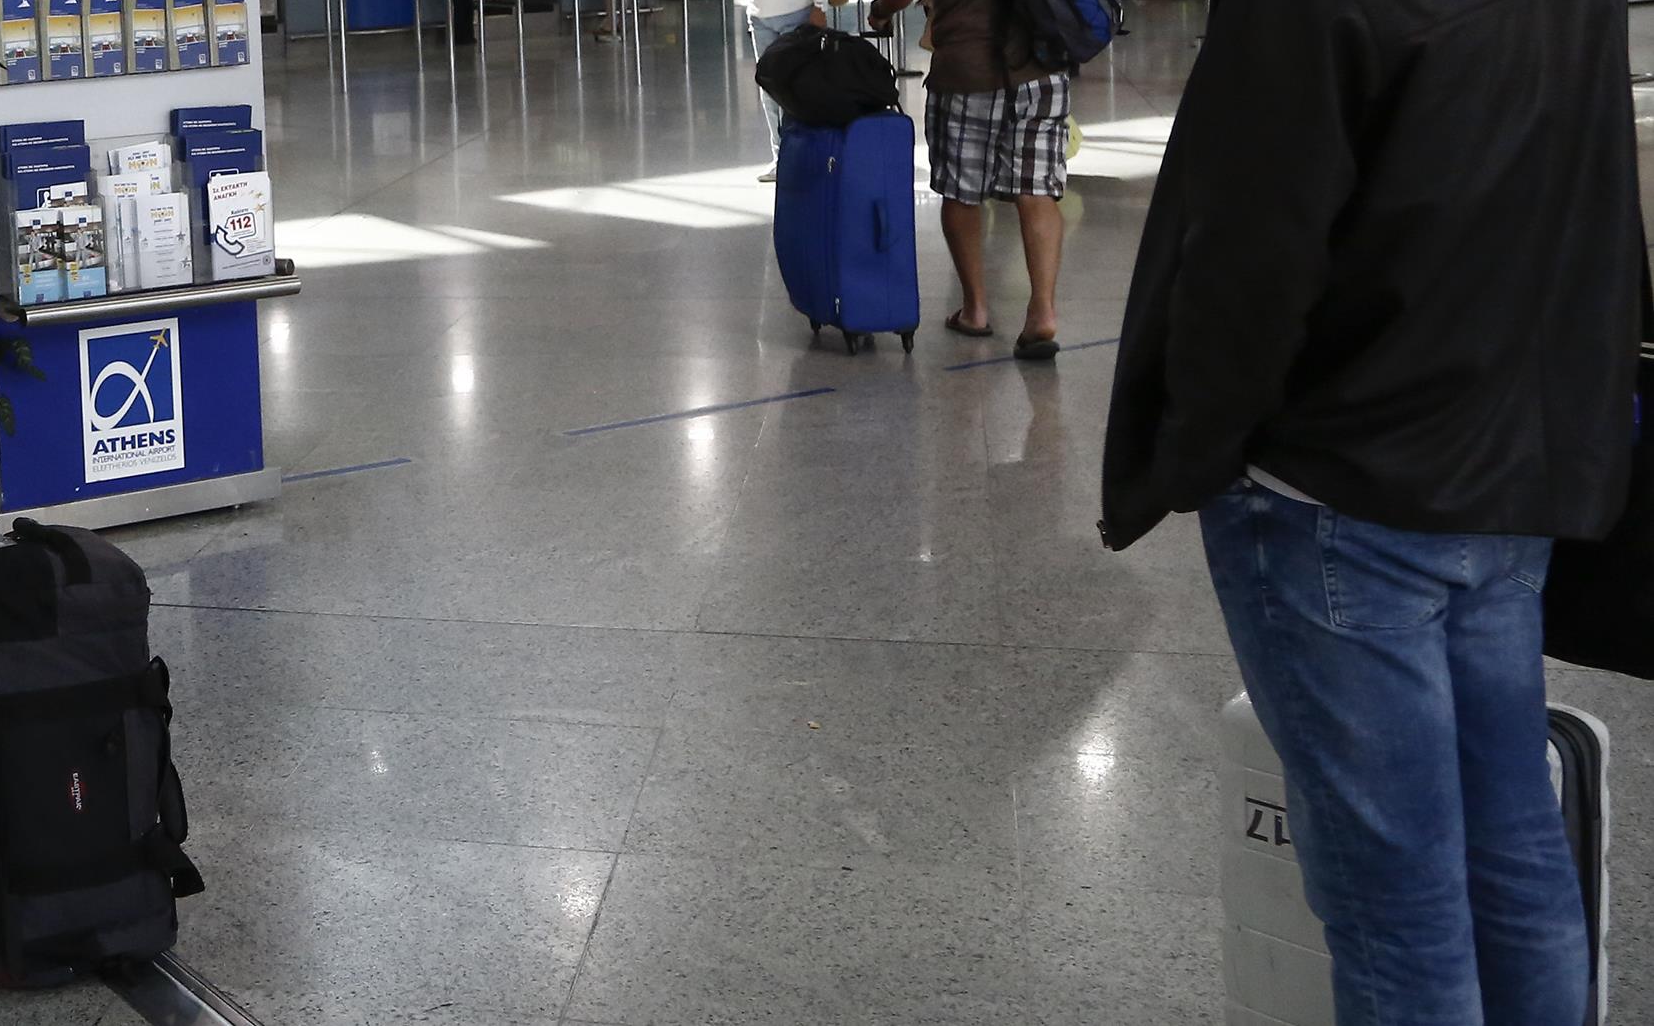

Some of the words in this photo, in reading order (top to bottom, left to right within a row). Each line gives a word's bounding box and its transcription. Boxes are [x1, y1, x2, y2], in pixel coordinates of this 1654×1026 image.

[230, 215, 252, 232] 112
[92, 429, 176, 455] ATHENS
[92, 451, 146, 464] INTERNATIONAL
[148, 445, 176, 455] AIRPORT
